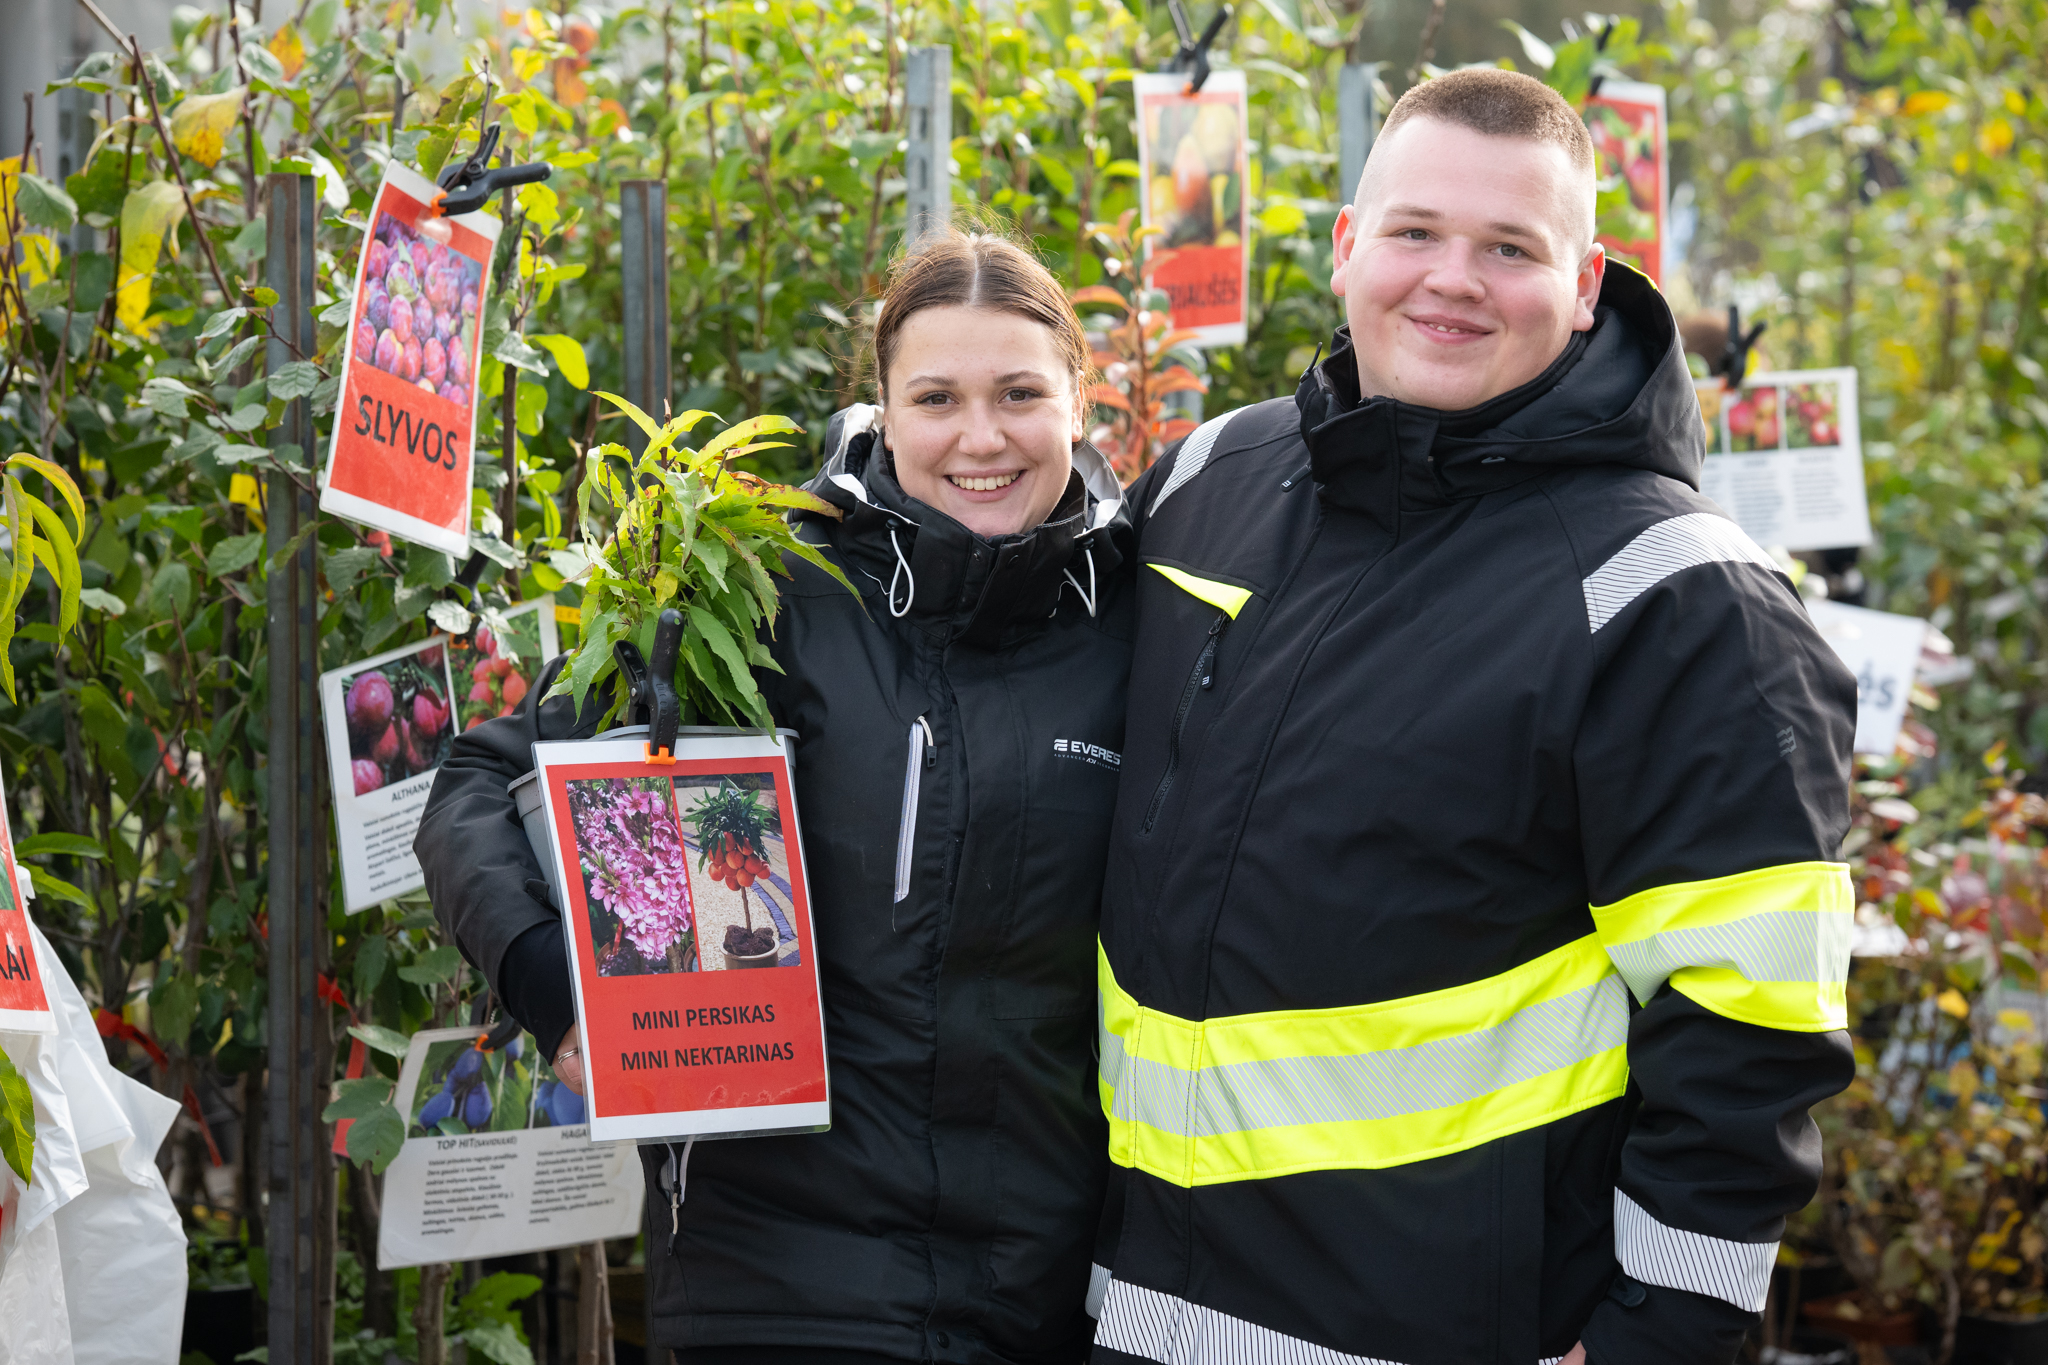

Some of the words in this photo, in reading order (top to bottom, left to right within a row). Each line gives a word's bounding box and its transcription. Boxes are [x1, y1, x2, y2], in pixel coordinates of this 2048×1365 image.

[354, 394, 458, 471] SLYVOS
[1071, 741, 1121, 766] EVERES
[391, 780, 431, 803] ALTHANA
[0, 944, 31, 981] AI
[632, 1009, 680, 1031] MINI
[685, 1004, 776, 1028] PERSIKAS
[621, 1049, 669, 1071] MINI
[674, 1041, 795, 1068] NEKTARINAS
[436, 1139, 457, 1150] TOP
[560, 1128, 588, 1140] HAGA
